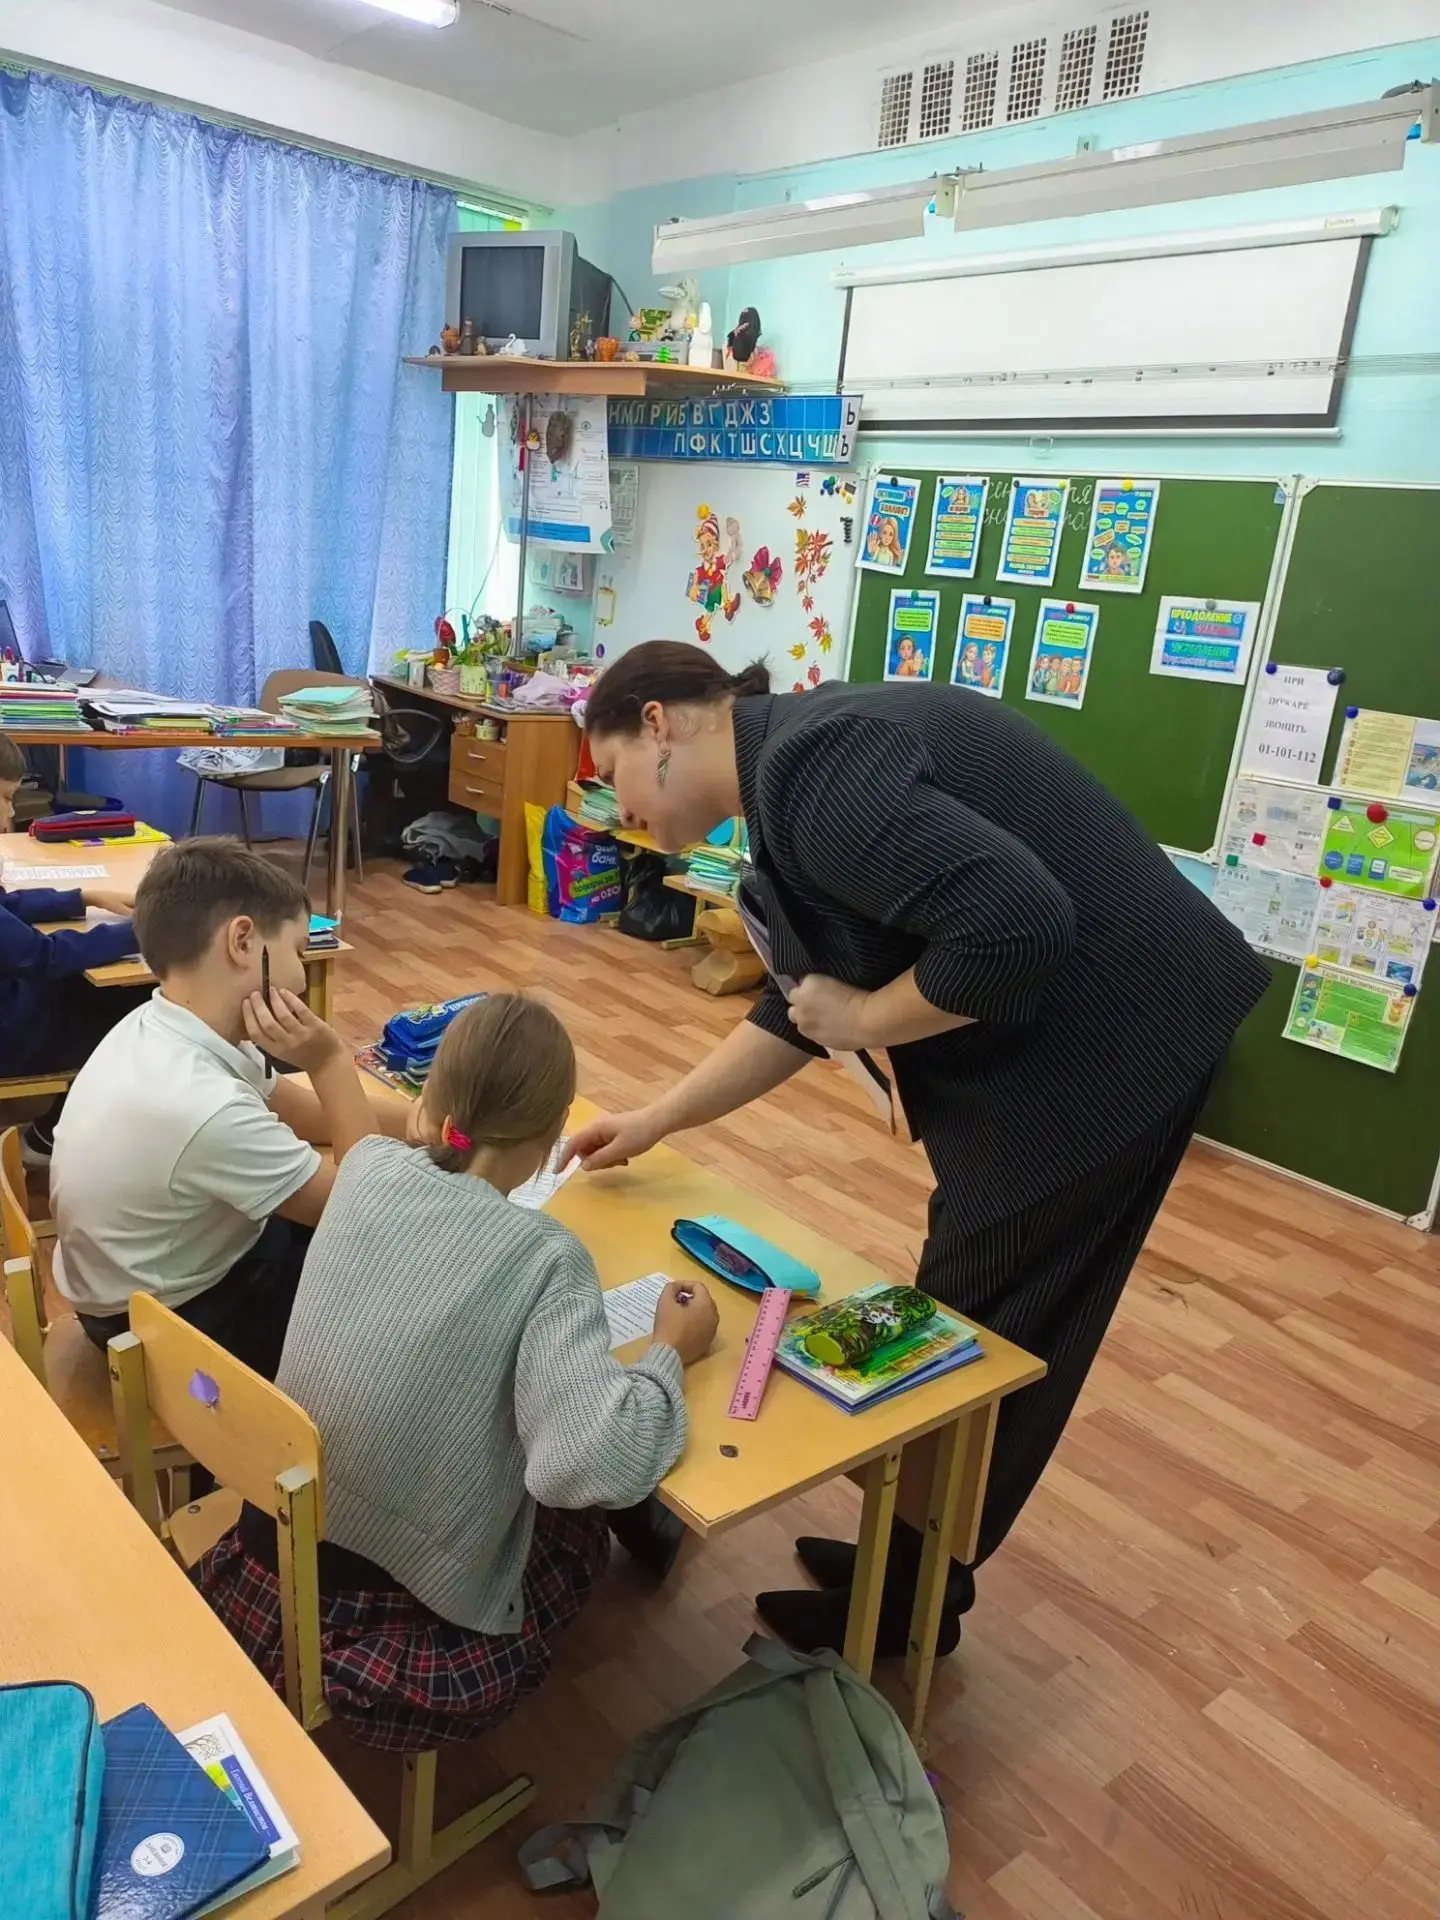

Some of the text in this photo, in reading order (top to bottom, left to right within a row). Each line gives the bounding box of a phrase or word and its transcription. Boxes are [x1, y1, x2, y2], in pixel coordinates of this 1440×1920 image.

[1284, 675, 1305, 686] ПРИ
[1264, 719, 1308, 734] ЗВОНИТЬ
[1258, 743, 1317, 764] 01-101-112
